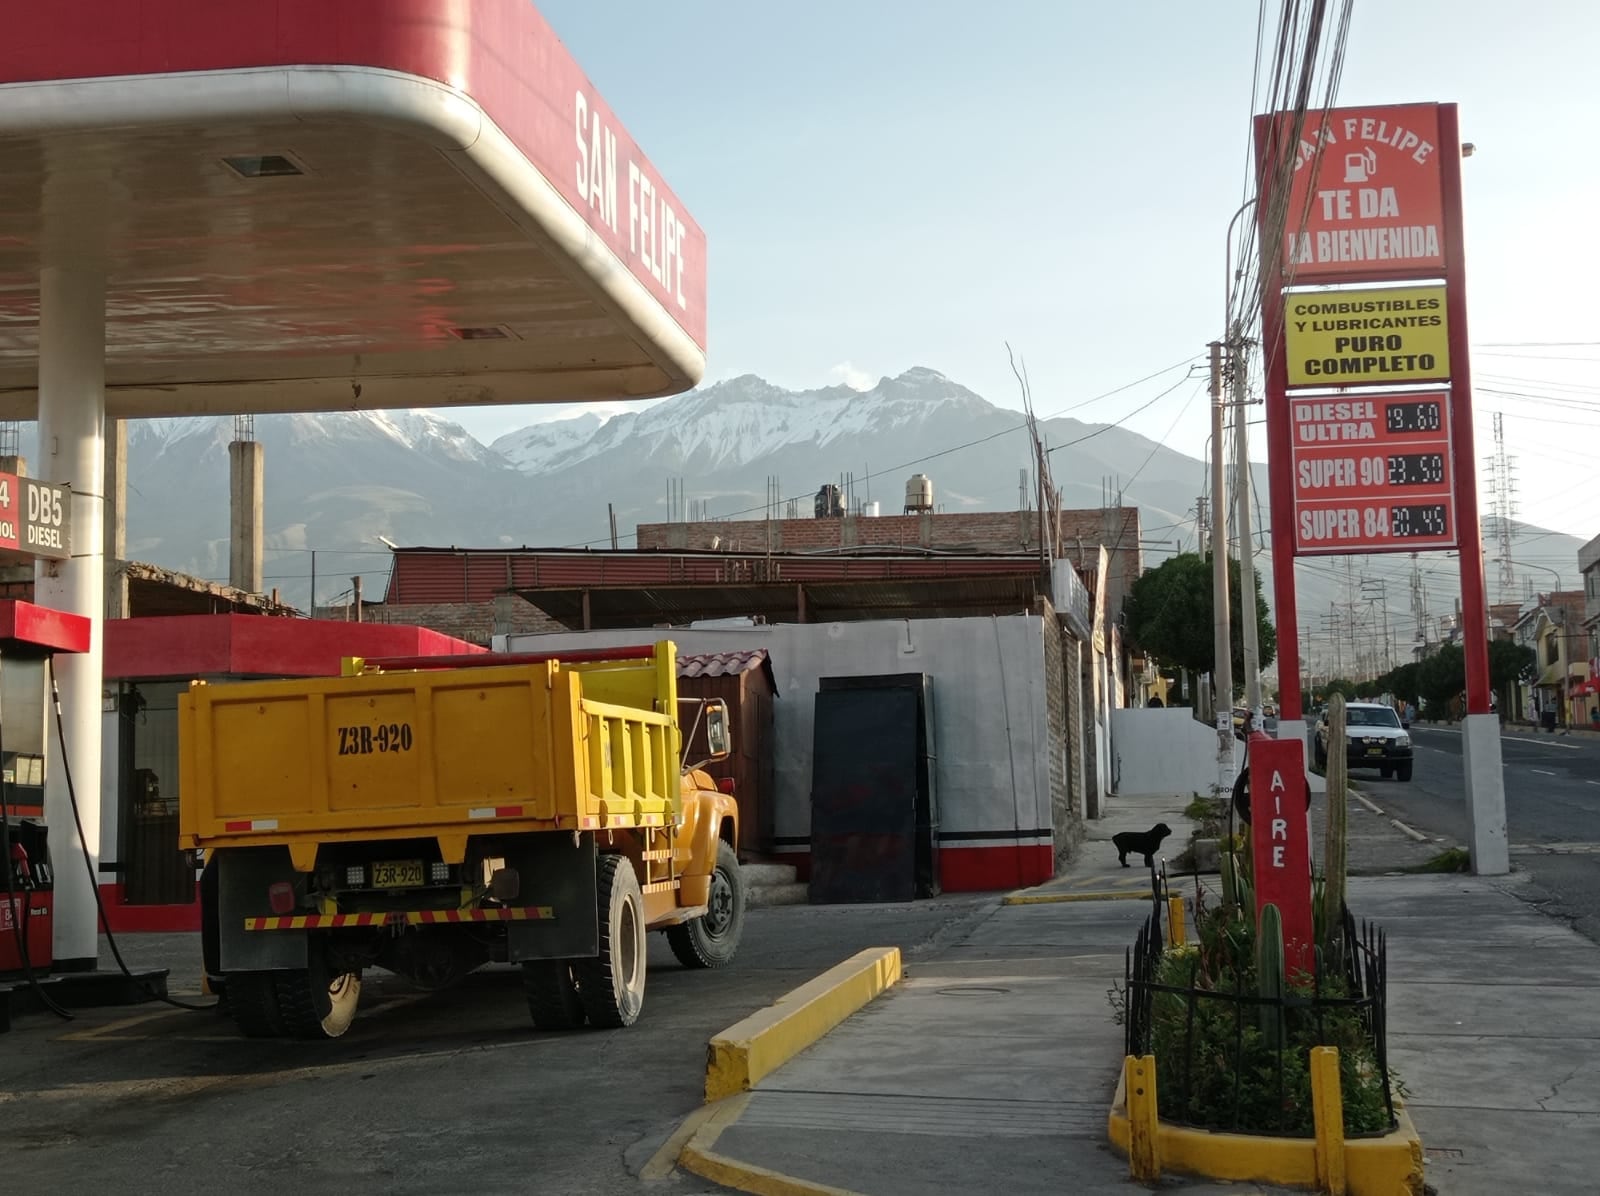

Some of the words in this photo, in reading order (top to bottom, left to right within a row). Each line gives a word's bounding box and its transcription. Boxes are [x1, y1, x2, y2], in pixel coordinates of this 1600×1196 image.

[1343, 118, 1433, 165] FELIPE
[576, 90, 617, 234] SAN
[629, 159, 686, 311] FELIPE
[1318, 190, 1352, 221] TE
[1359, 187, 1399, 219] DA
[1288, 231, 1313, 265] LA
[1317, 225, 1439, 263] BIENVENIDA
[1295, 298, 1440, 316] COMBUSTIBLES
[1295, 321, 1308, 332] Y
[1313, 315, 1441, 332] LUBRICANTES
[1335, 334, 1402, 353] PURO
[1305, 354, 1435, 375] COMPLETO
[1295, 402, 1377, 422] DIESEL
[1300, 422, 1375, 442] ULTRA
[1299, 458, 1357, 488] SUPER
[1360, 456, 1384, 486] 90
[1387, 456, 1442, 484] 23.50
[28, 484, 63, 527] DB5
[28, 524, 63, 549] DIESEL
[1301, 508, 1360, 540] SUPER
[1364, 507, 1389, 538] 84
[1392, 506, 1444, 536] 20.45
[338, 723, 412, 756] Z3R-920
[1270, 770, 1287, 868] AIRE
[375, 866, 421, 883] Z3R-920
